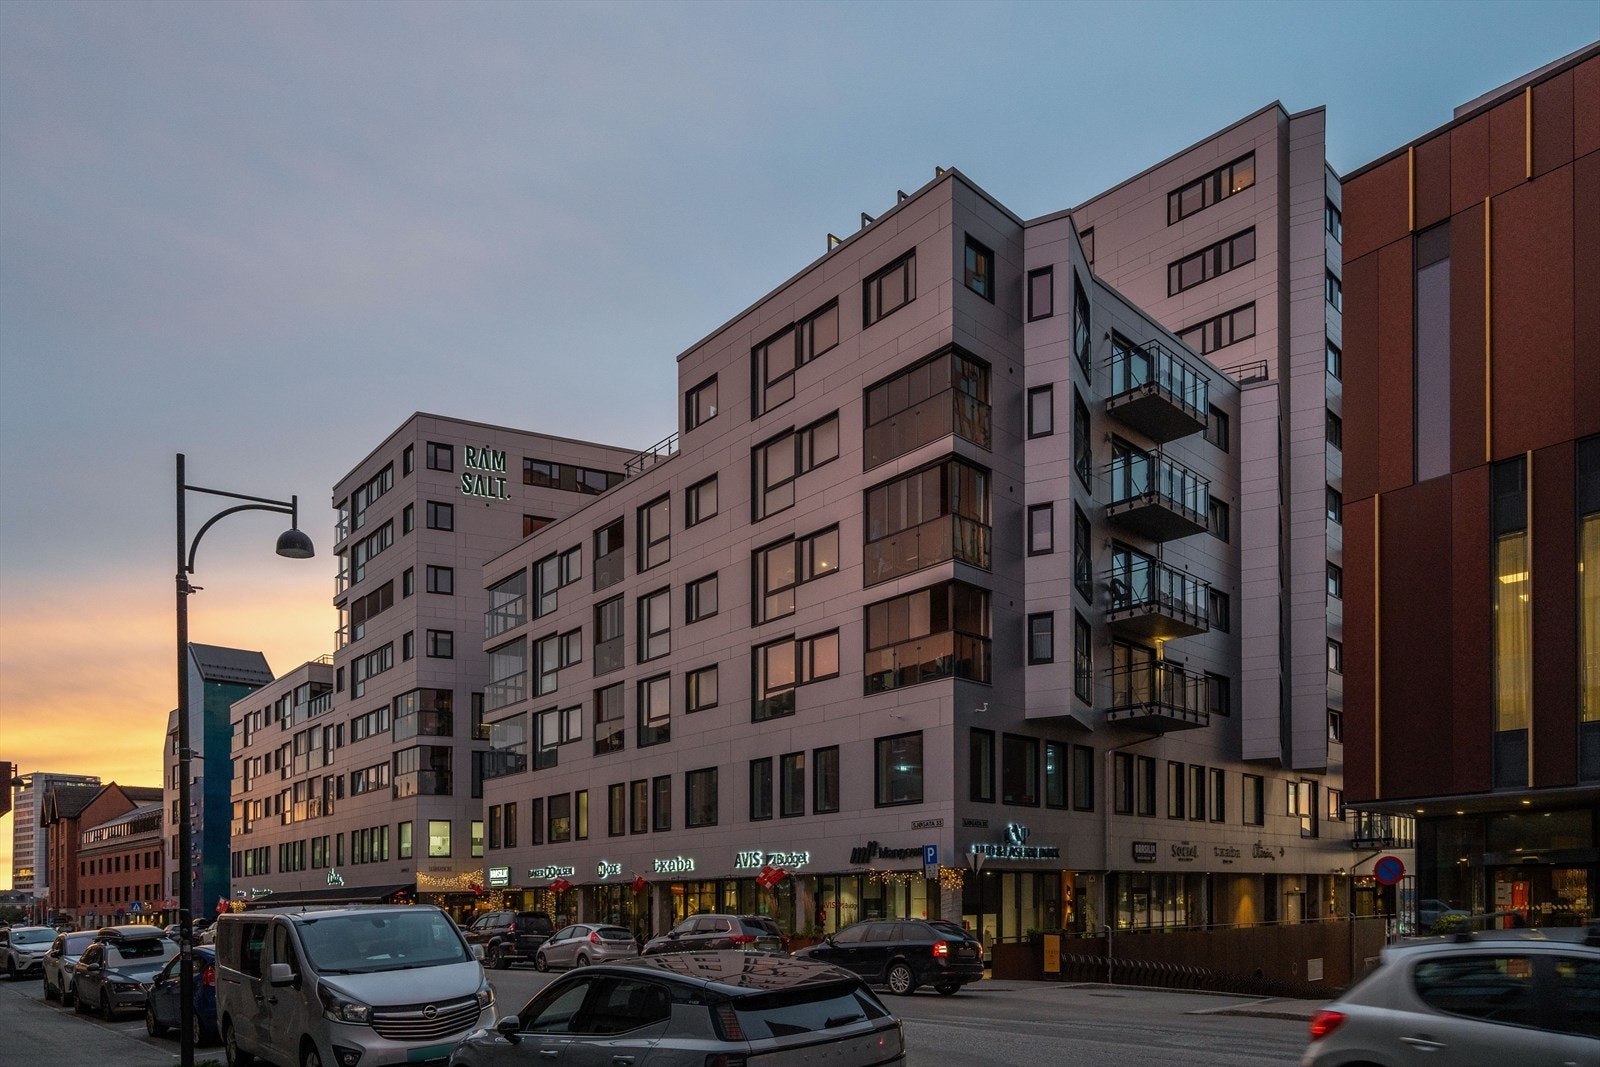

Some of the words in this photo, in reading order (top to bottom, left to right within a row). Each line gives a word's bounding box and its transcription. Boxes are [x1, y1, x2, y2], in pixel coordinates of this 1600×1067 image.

[734, 851, 762, 868] AVIS
[775, 851, 809, 868] Budget
[927, 847, 935, 862] P
[653, 856, 694, 872] txaba
